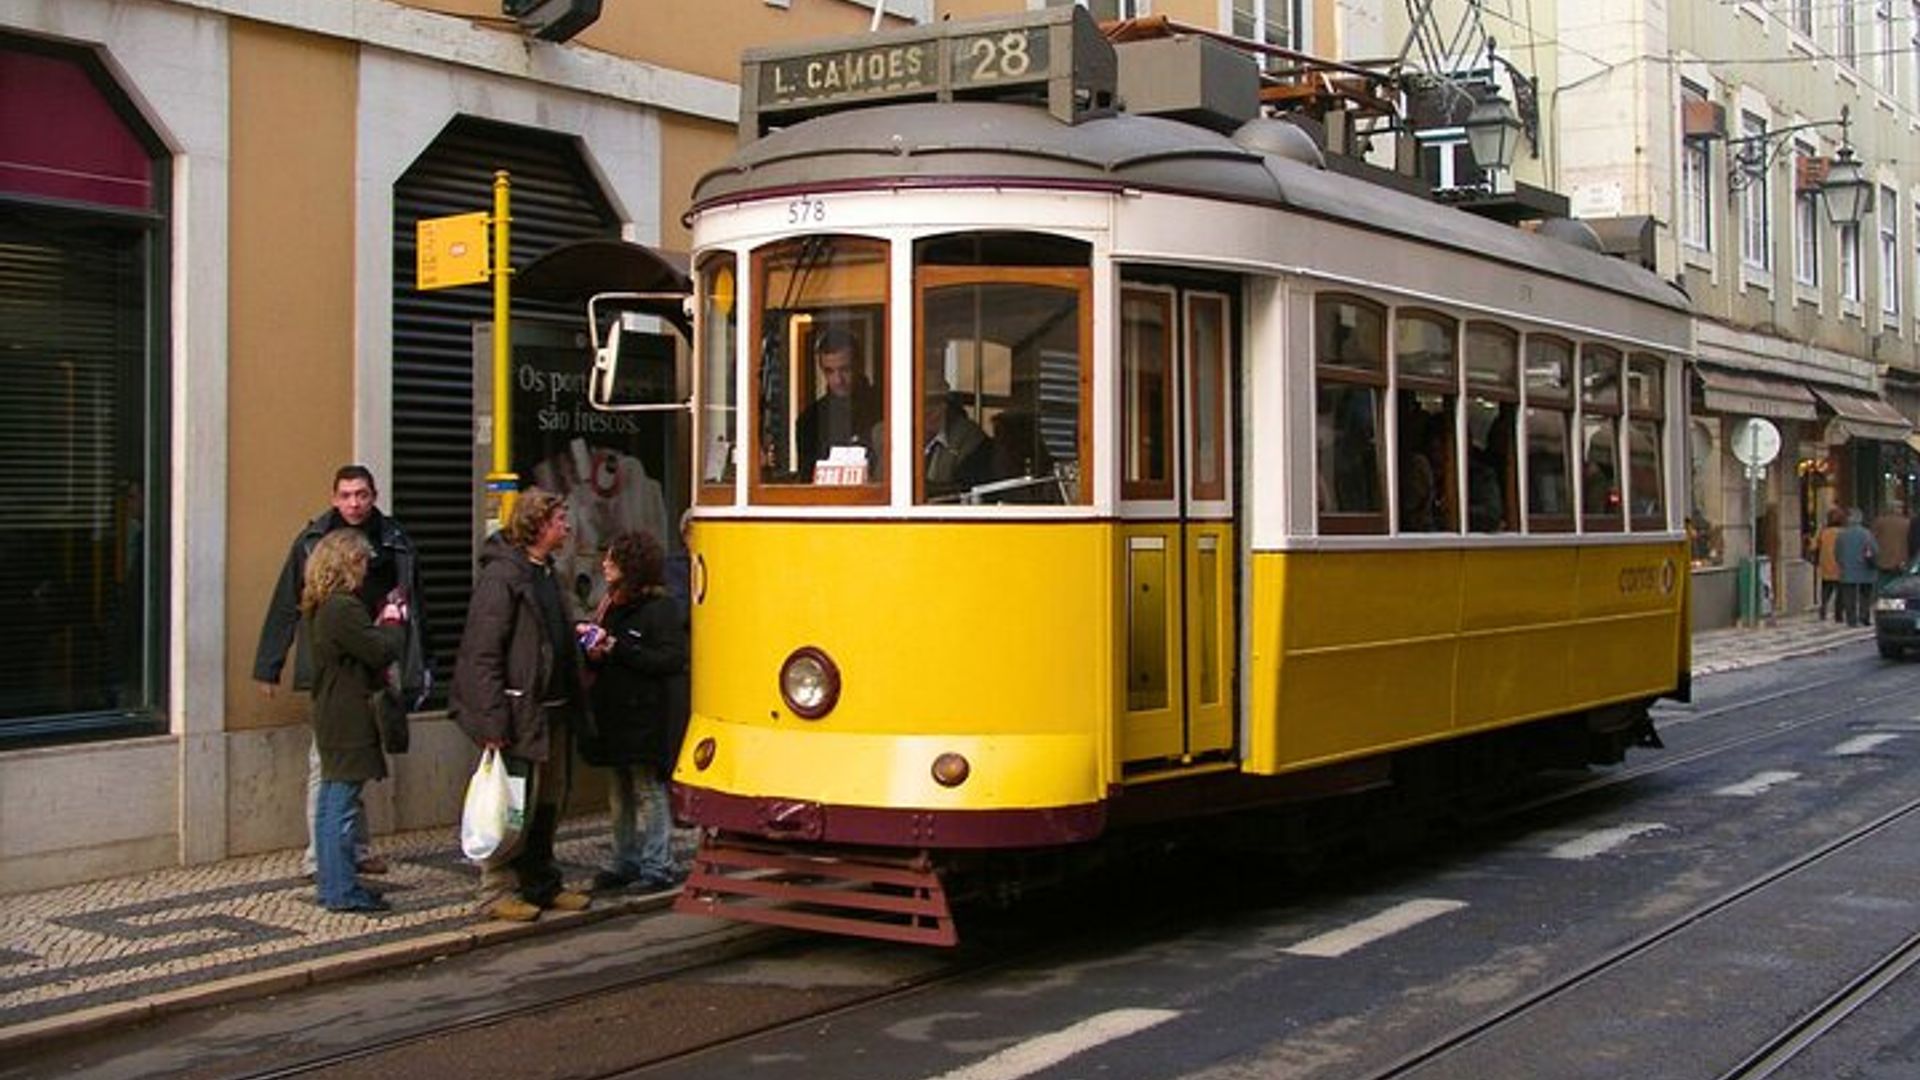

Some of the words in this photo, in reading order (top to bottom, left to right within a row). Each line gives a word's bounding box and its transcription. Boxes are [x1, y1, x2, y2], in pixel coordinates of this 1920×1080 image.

[971, 32, 1031, 80] 28
[774, 66, 797, 94] L.
[788, 200, 826, 224] 578
[518, 364, 545, 393] Os
